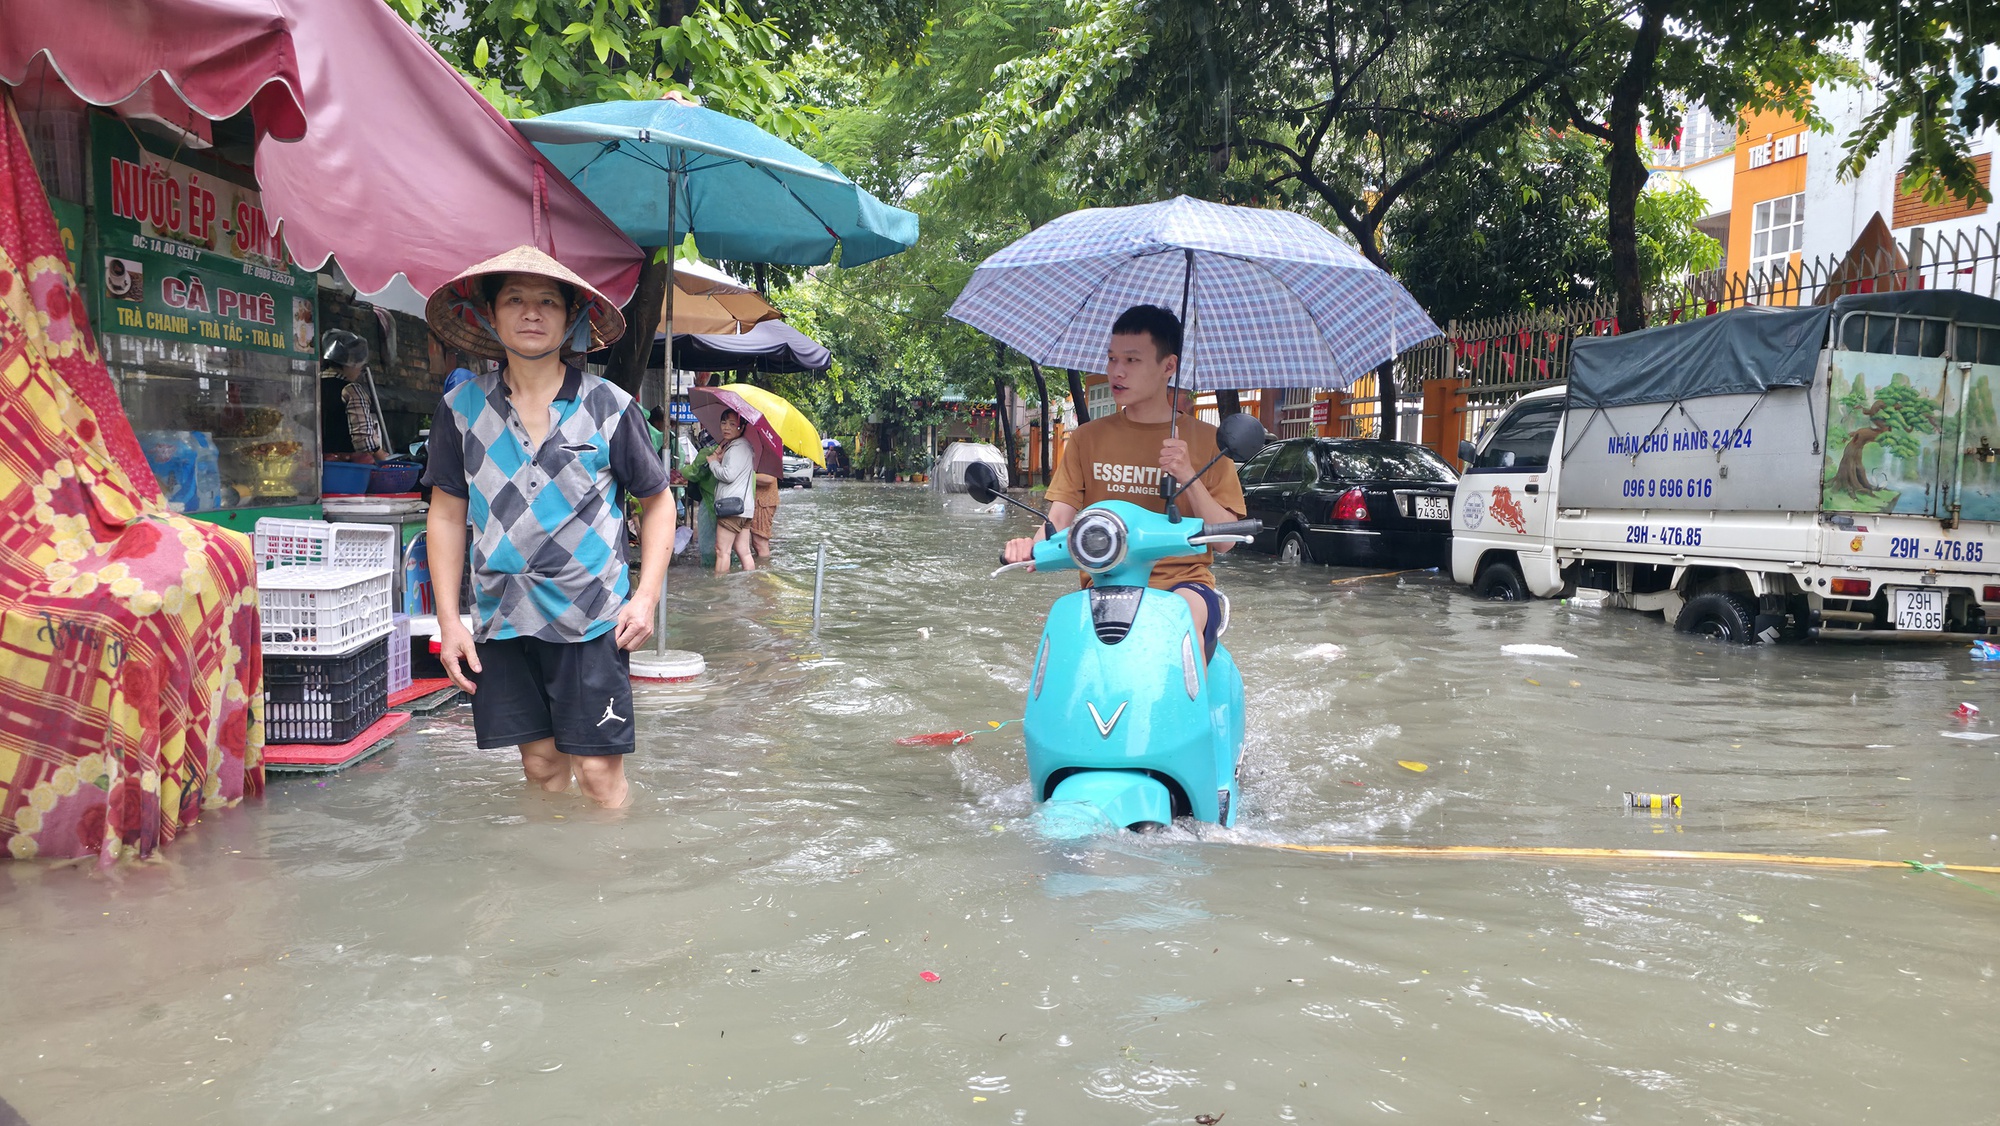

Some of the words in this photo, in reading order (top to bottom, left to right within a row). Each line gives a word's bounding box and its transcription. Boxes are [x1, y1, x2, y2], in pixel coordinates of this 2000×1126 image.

[1774, 134, 1797, 162] EM
[111, 156, 182, 232] NƯỚC
[188, 175, 216, 240] ÉP
[150, 239, 162, 252] 1A
[163, 242, 176, 255] AO
[195, 250, 202, 262] 7
[161, 276, 210, 313] CÀ
[217, 288, 276, 325] PHÊ
[117, 306, 143, 328] TRÀ
[146, 311, 189, 334] CHANH
[199, 320, 221, 340] TRÀ
[222, 320, 243, 342] TẮC
[252, 328, 271, 347] TRÀ
[1608, 432, 1639, 457] NHẬN
[1643, 427, 1669, 453] CHỞ
[1673, 428, 1708, 451] HÀNG
[1712, 428, 1752, 451] 24/24
[1093, 462, 1181, 488] ESSENTI
[1107, 483, 1126, 493] LOS
[1128, 485, 1161, 496] ANGEL
[1623, 479, 1645, 497] 096
[1648, 479, 1656, 497] 9
[1659, 479, 1682, 497] 696
[1687, 478, 1712, 497] 616
[1418, 507, 1449, 519] 743.90
[1424, 497, 1441, 507] 30E
[1626, 525, 1649, 543] 29H
[1659, 526, 1702, 546] 476.85
[1890, 537, 1919, 558] 29H
[1934, 540, 1983, 562] 476.85
[1907, 593, 1931, 610] 29H
[1898, 612, 1941, 629] 476.85
